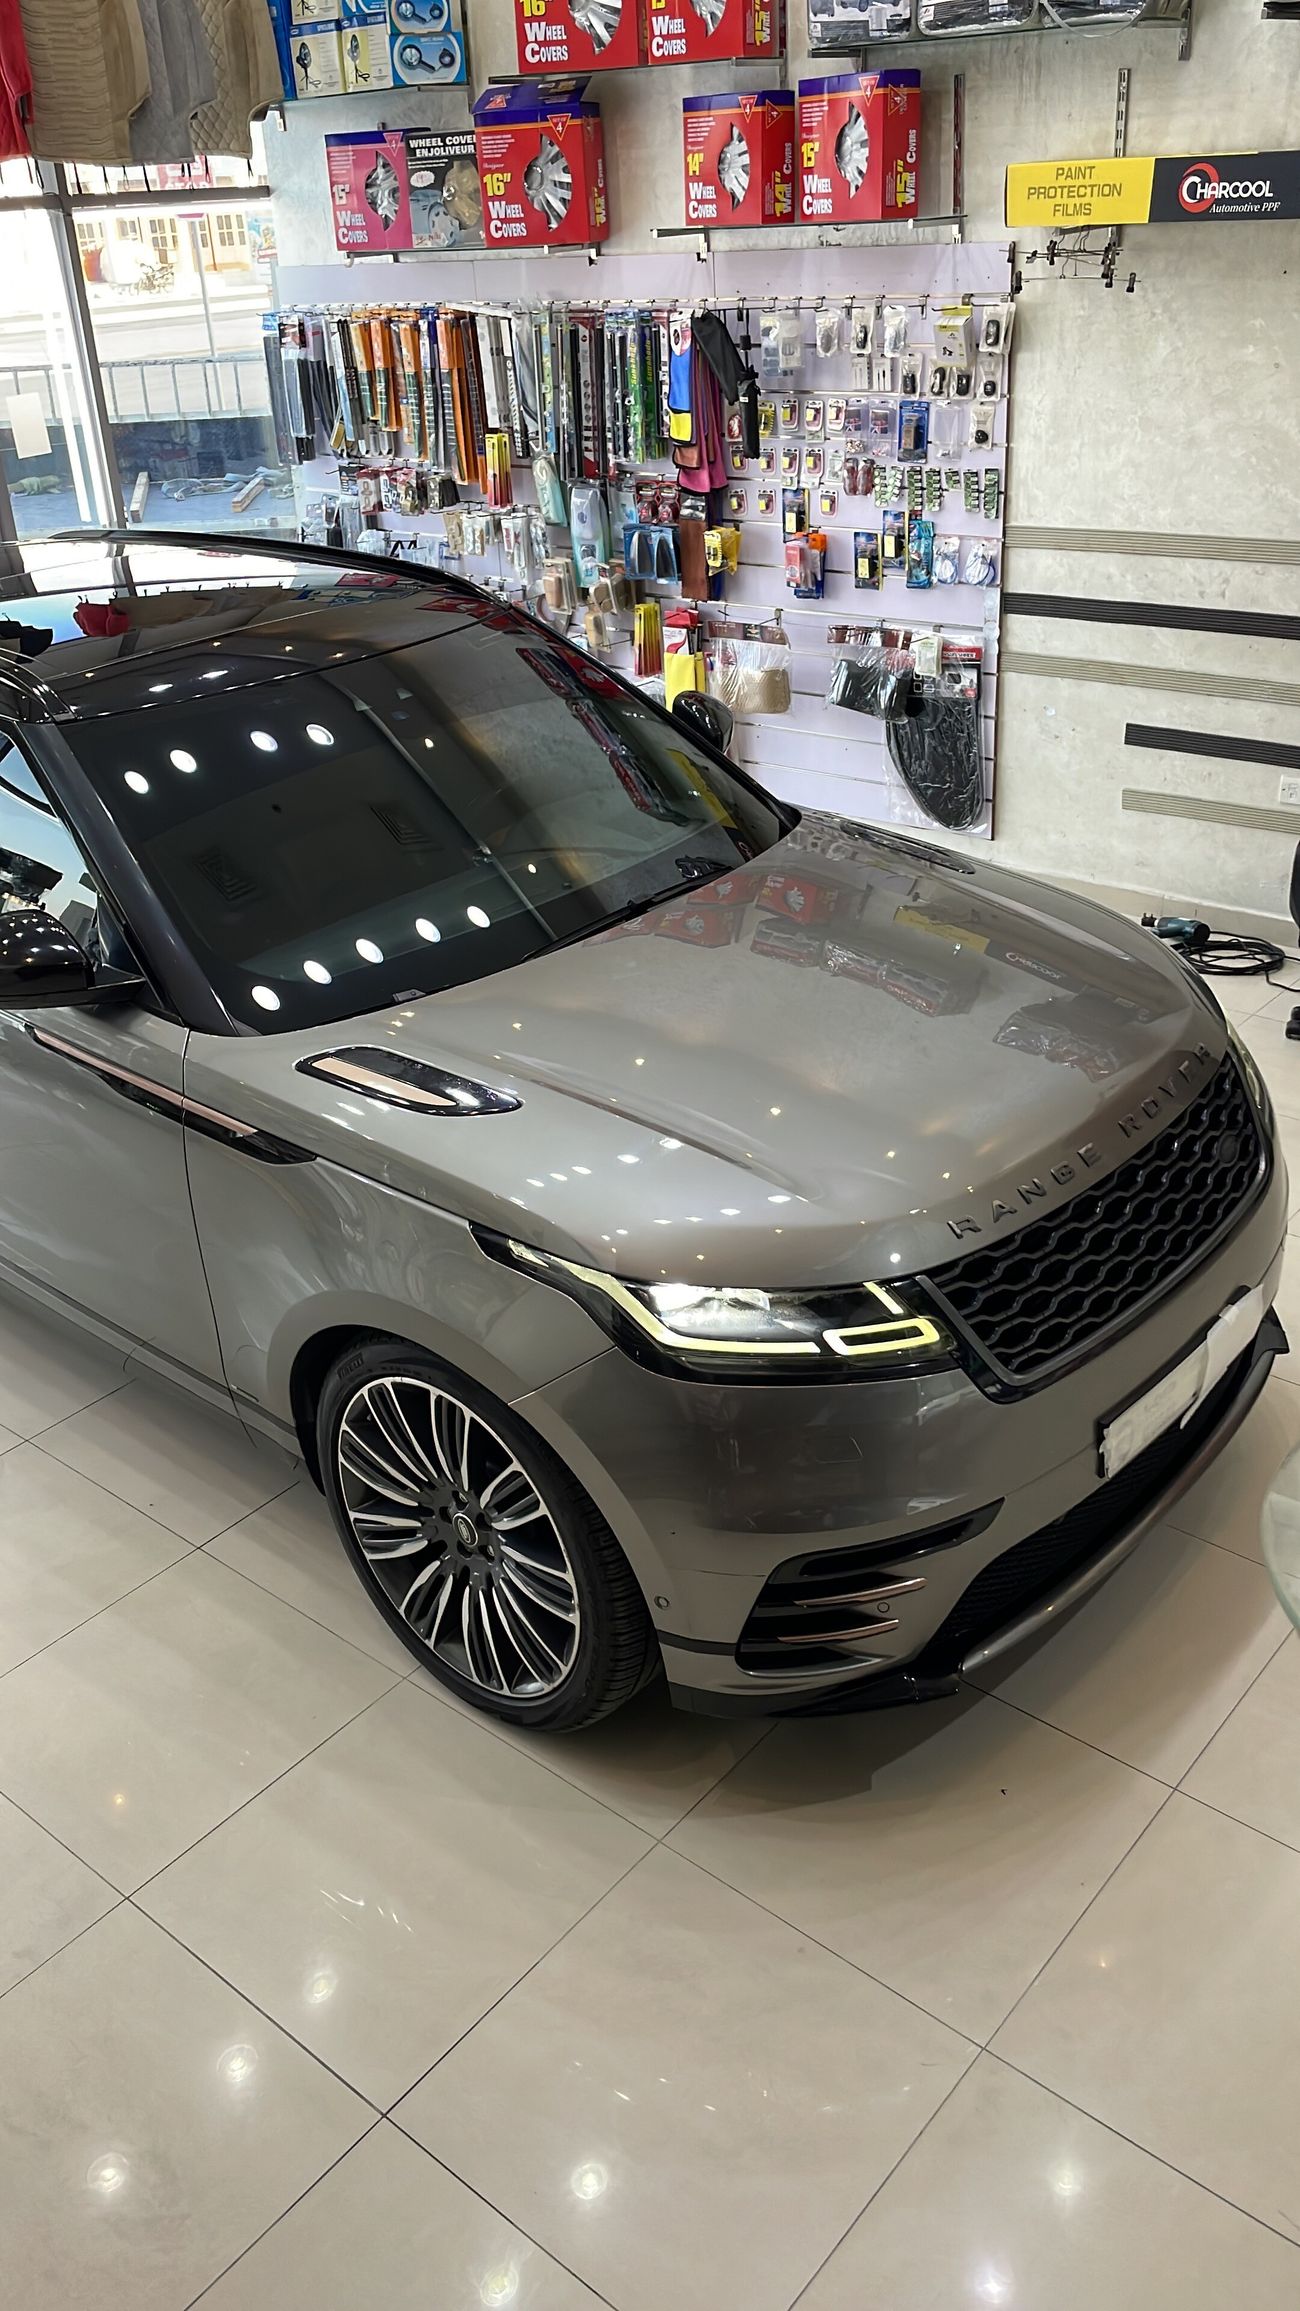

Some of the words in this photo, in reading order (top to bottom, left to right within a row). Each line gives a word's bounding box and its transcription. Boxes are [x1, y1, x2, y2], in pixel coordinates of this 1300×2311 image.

[520, 0, 553, 17] 16
[523, 21, 567, 42] WHEEL
[651, 15, 686, 36] WHEEL
[524, 42, 569, 64] COVERS
[651, 36, 687, 58] COVERS
[555, 121, 563, 134] 4
[409, 136, 444, 149] WHEEL
[446, 134, 477, 147] COVE
[415, 144, 475, 158] ENJOLIVEUR
[906, 129, 917, 163] COVERS
[686, 152, 704, 177] 14"
[783, 142, 792, 175] COVERS
[801, 141, 820, 168] 15"
[1055, 165, 1096, 181] PAINT
[482, 172, 512, 197] 16"
[688, 182, 717, 200] WHEEL
[774, 170, 786, 217] 14"
[802, 174, 832, 194] WHEEL
[896, 159, 909, 208] 15"
[1027, 183, 1123, 200] PROTECTION
[1181, 175, 1274, 204] CHARCOOL
[488, 201, 525, 219] WHEEL
[688, 200, 718, 219] COVERS
[802, 194, 833, 216] COVERS
[1053, 202, 1092, 217] FILMS
[1209, 202, 1261, 214] Automotive
[1261, 201, 1281, 212] PPF
[336, 210, 366, 227] WHEEL
[338, 227, 369, 244] COVERS
[489, 219, 528, 239] COVERS
[946, 1142, 1103, 1239] RANGE
[1117, 1042, 1211, 1138] ROVER
